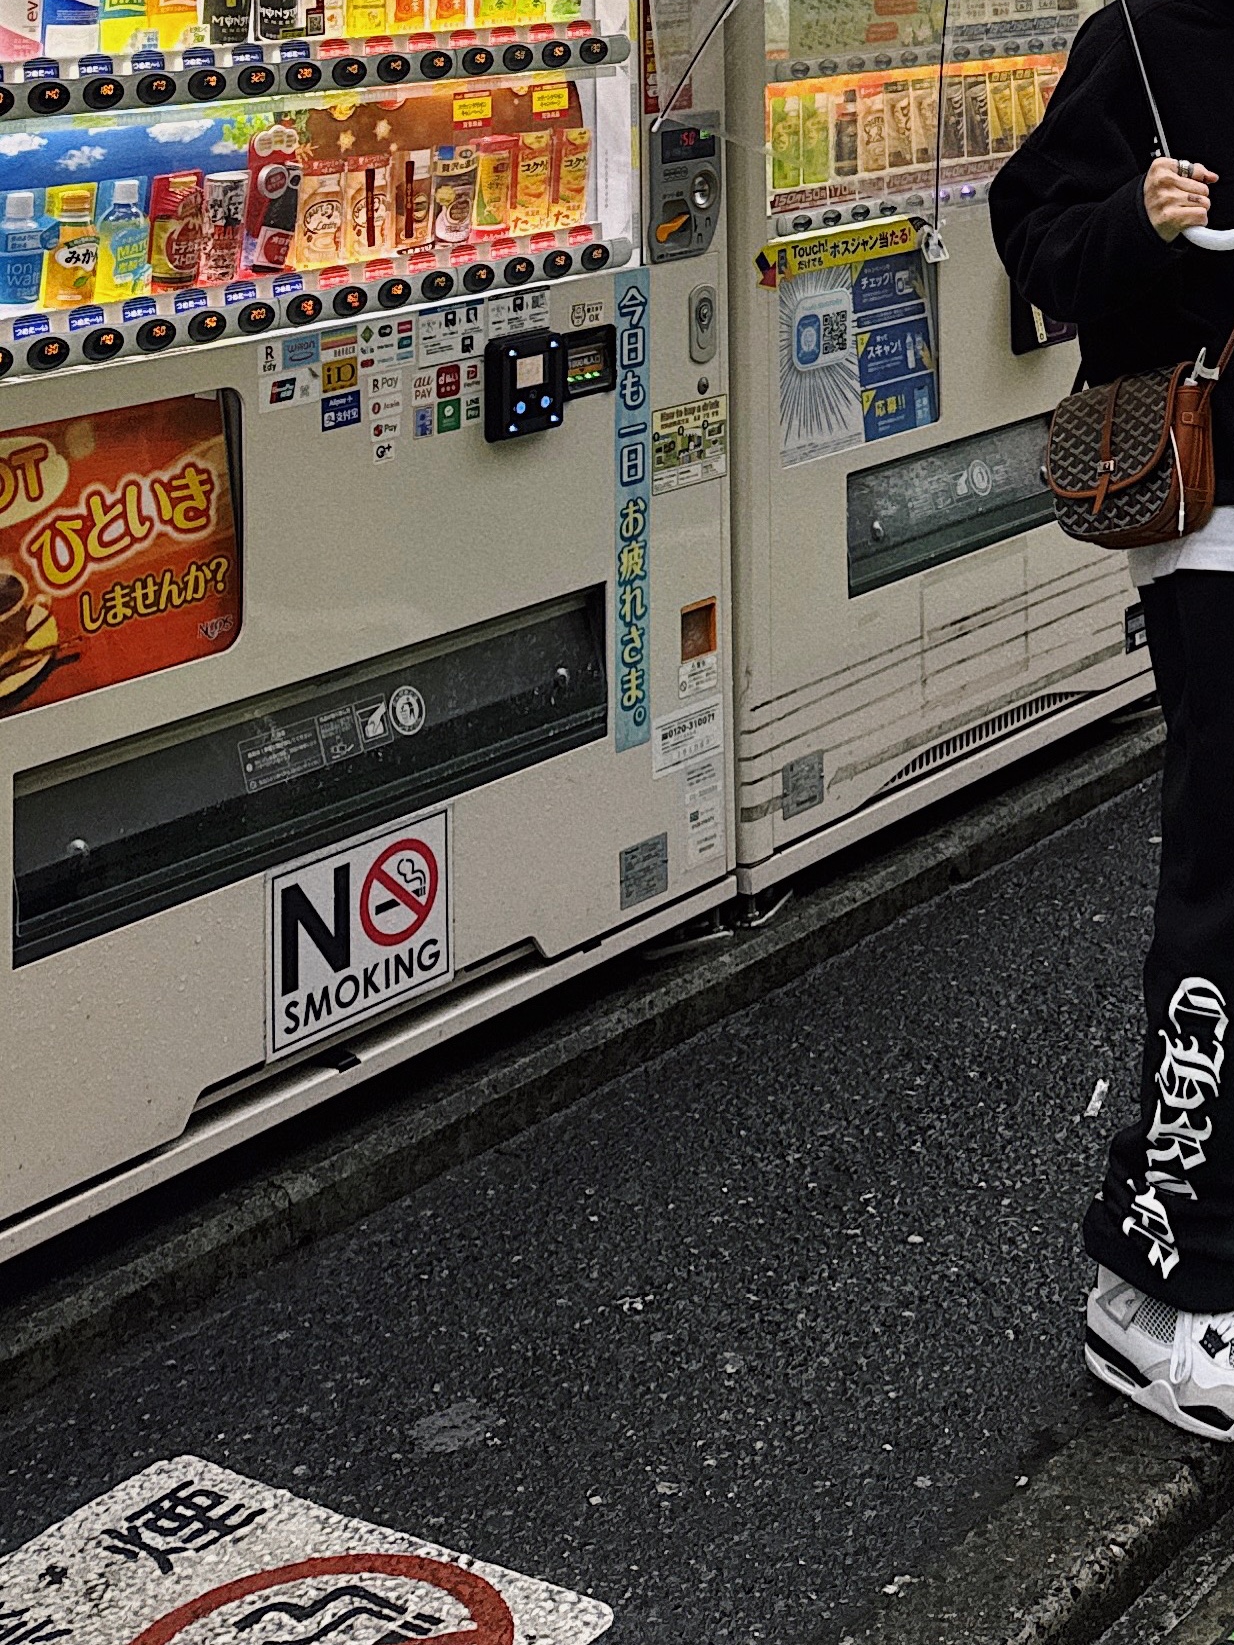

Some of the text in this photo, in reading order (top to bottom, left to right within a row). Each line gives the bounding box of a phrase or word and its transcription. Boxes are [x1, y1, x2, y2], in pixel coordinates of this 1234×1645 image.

[791, 238, 829, 260] Touch!
[7, 262, 33, 275] ion
[860, 271, 894, 291] チェック!
[866, 339, 902, 360] スキャン!
[326, 361, 356, 385] iD
[381, 375, 399, 390] Pay
[413, 375, 433, 389] au
[414, 388, 433, 400] PAY
[618, 286, 648, 727] 今日も 一日 お疲れさま。
[29, 464, 213, 586] ひといき
[79, 557, 229, 633] しませんか?
[282, 938, 441, 1036] SMOKING
